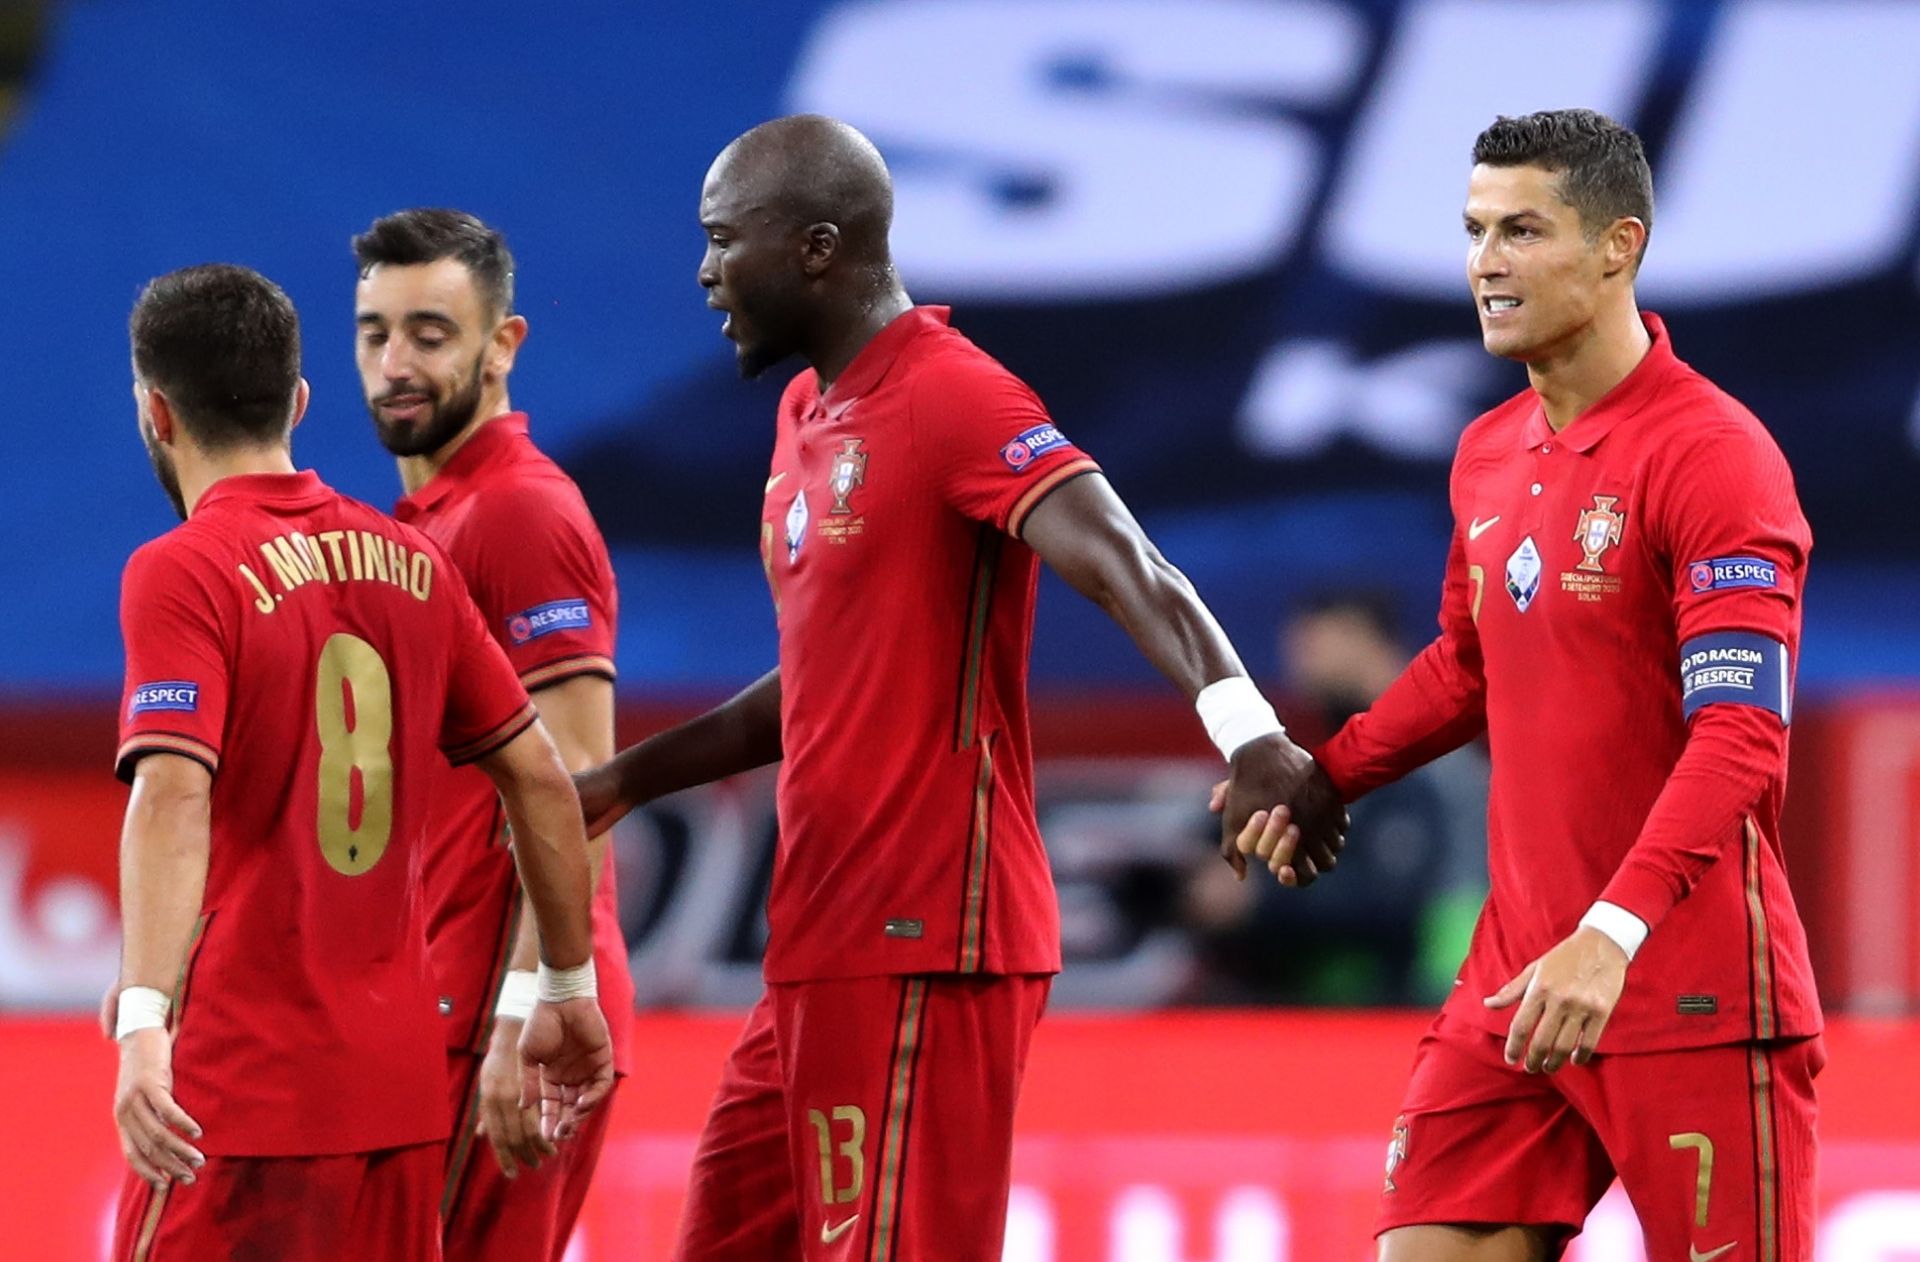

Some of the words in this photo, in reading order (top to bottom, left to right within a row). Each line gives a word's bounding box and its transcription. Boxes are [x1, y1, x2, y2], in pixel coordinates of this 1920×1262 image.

[1714, 564, 1775, 583] RESPECT
[529, 605, 588, 629] RESPECT
[1691, 651, 1708, 667] TO
[1709, 648, 1763, 664] RACISM
[1694, 669, 1754, 687] RESPECT
[316, 633, 393, 876] 8
[808, 1104, 866, 1205] 13
[1668, 1132, 1714, 1228] 7
